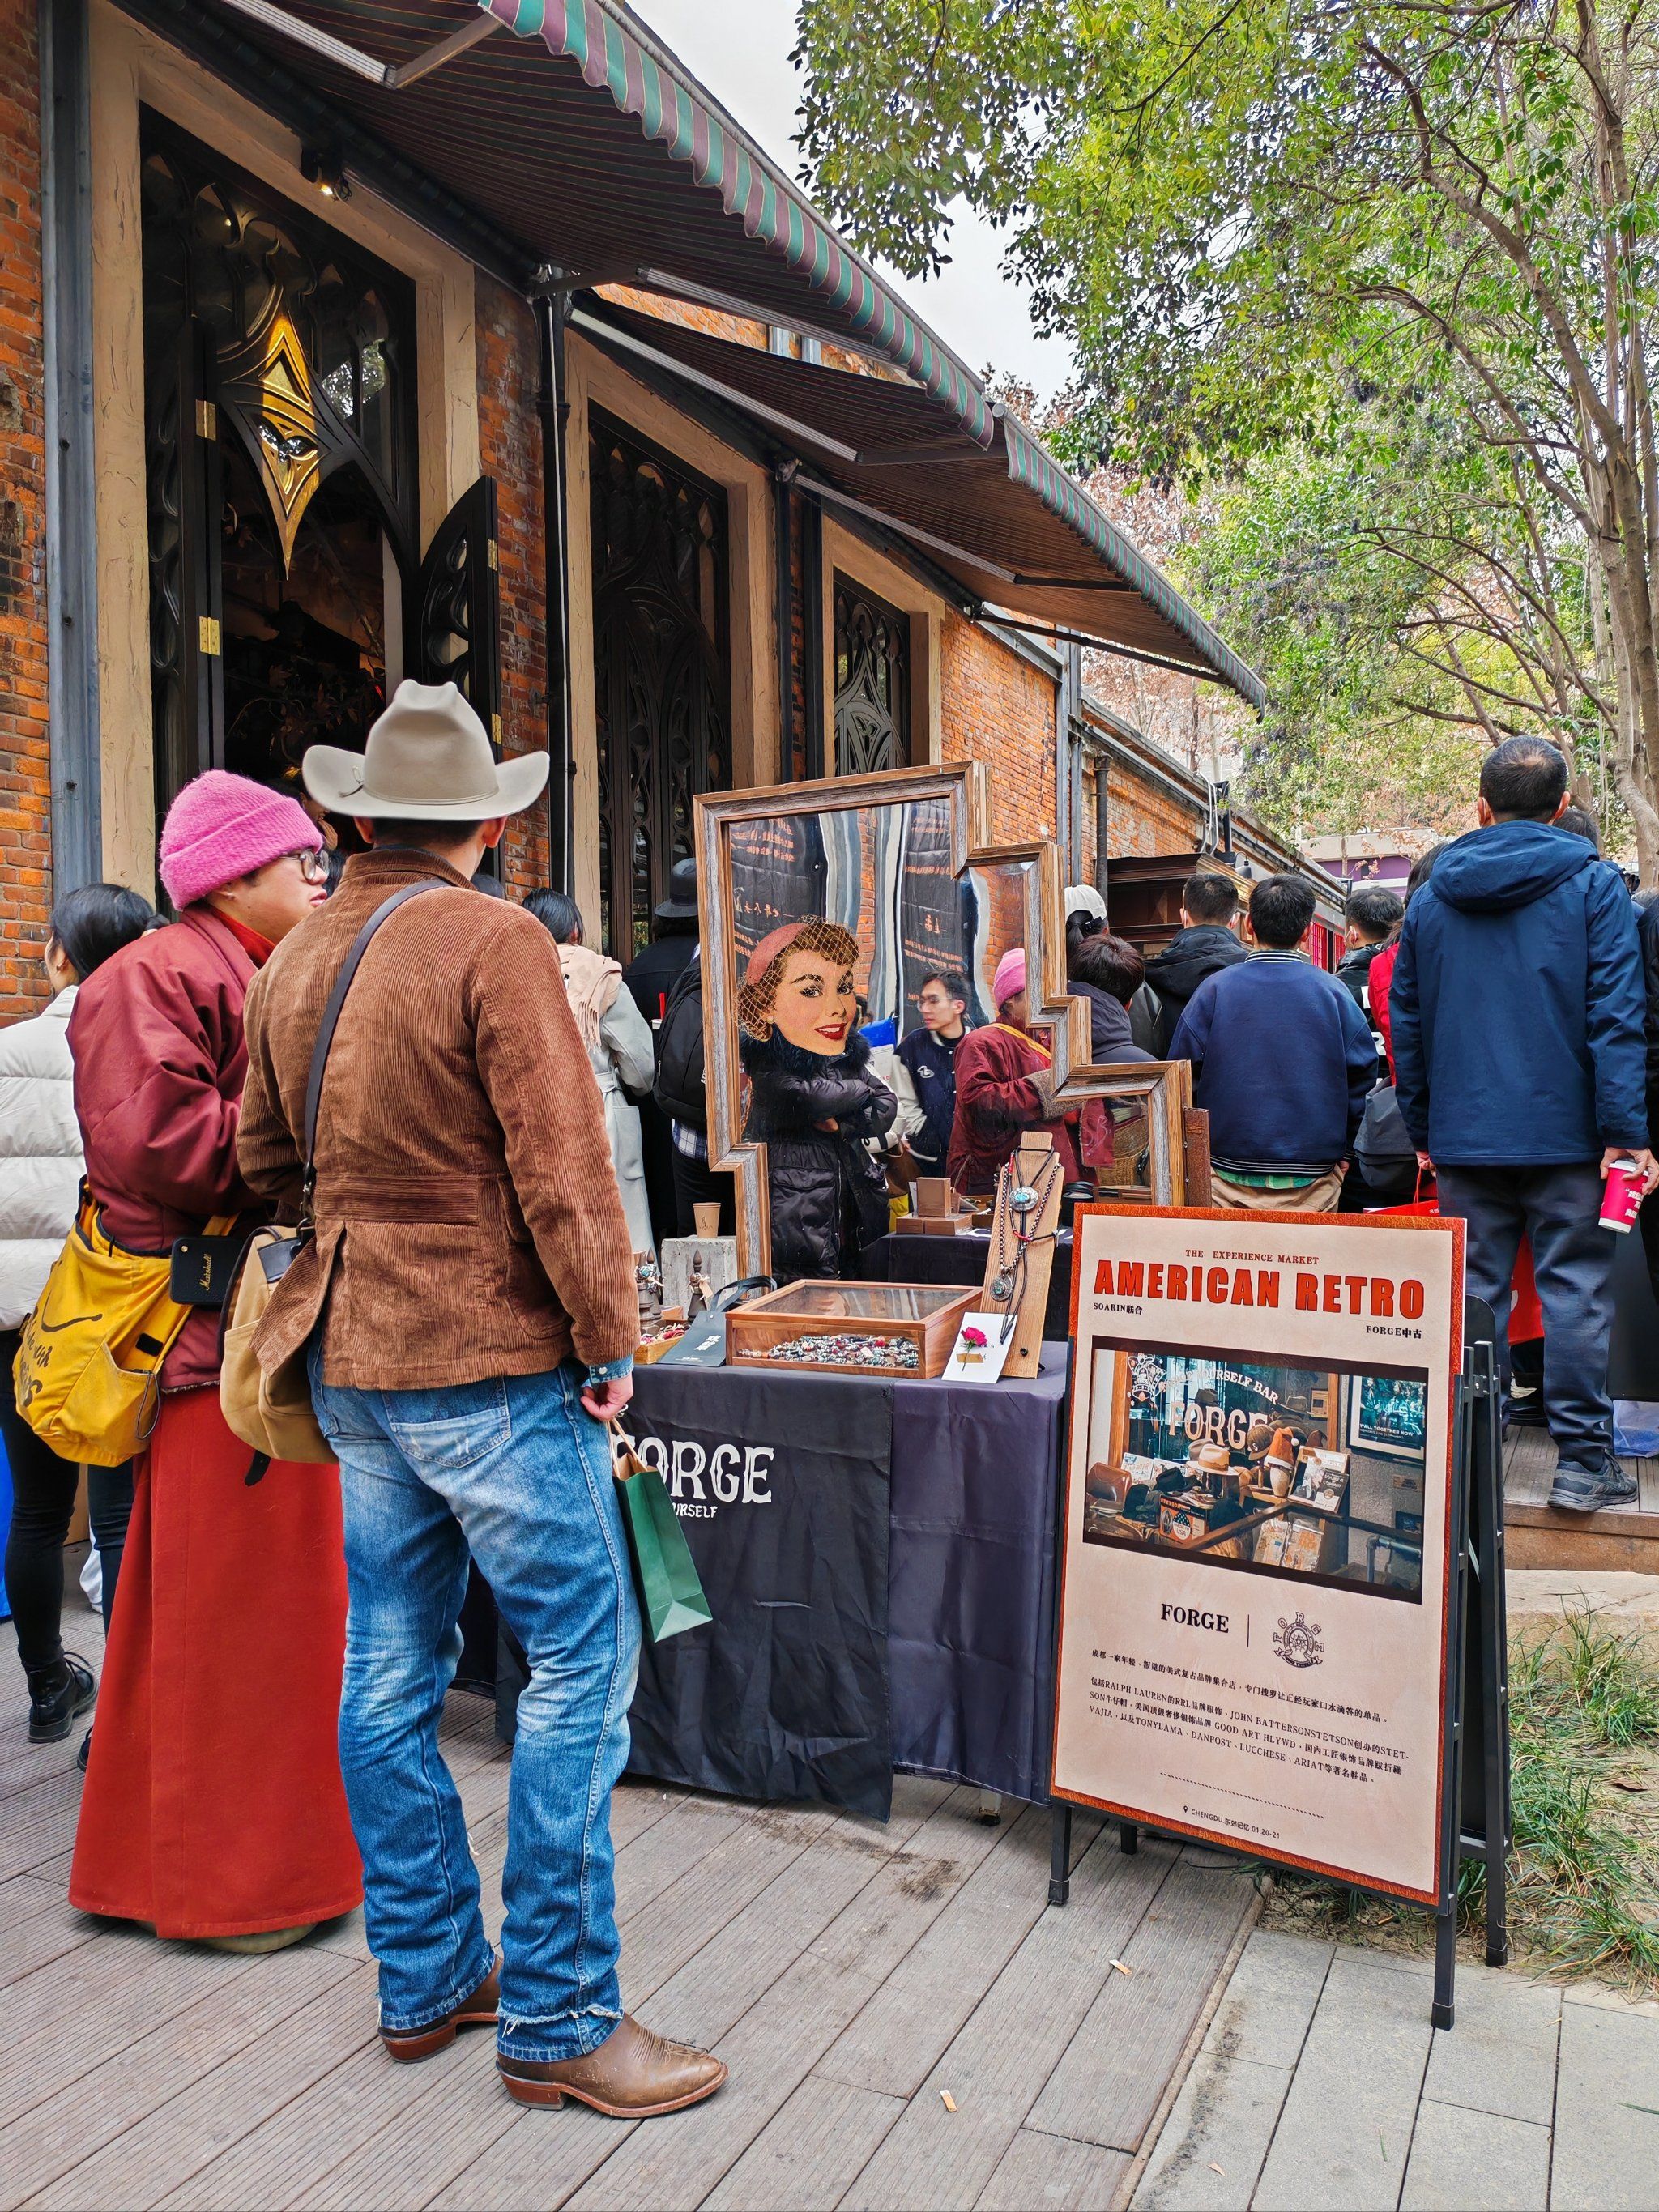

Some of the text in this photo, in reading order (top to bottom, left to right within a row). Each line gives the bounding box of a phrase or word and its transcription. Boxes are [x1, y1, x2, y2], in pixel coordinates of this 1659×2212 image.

[1185, 1249, 1320, 1265] THE EXPERIENCE MARKET
[199, 1253, 212, 1291] Marshall
[1094, 1259, 1425, 1319] AMERICAN RETRO
[1093, 1302, 1143, 1315] SOARIN联合
[1366, 1325, 1422, 1340] FORGE中古
[1253, 1380, 1279, 1405] BAR
[672, 1502, 719, 1519] URSELF
[1160, 1603, 1230, 1634] FORGE
[1273, 1612, 1325, 1653] FORGE
[1214, 1721, 1239, 1734] GOOD
[1242, 1728, 1260, 1740] ART
[1251, 1826, 1281, 1839] 01.20-21
